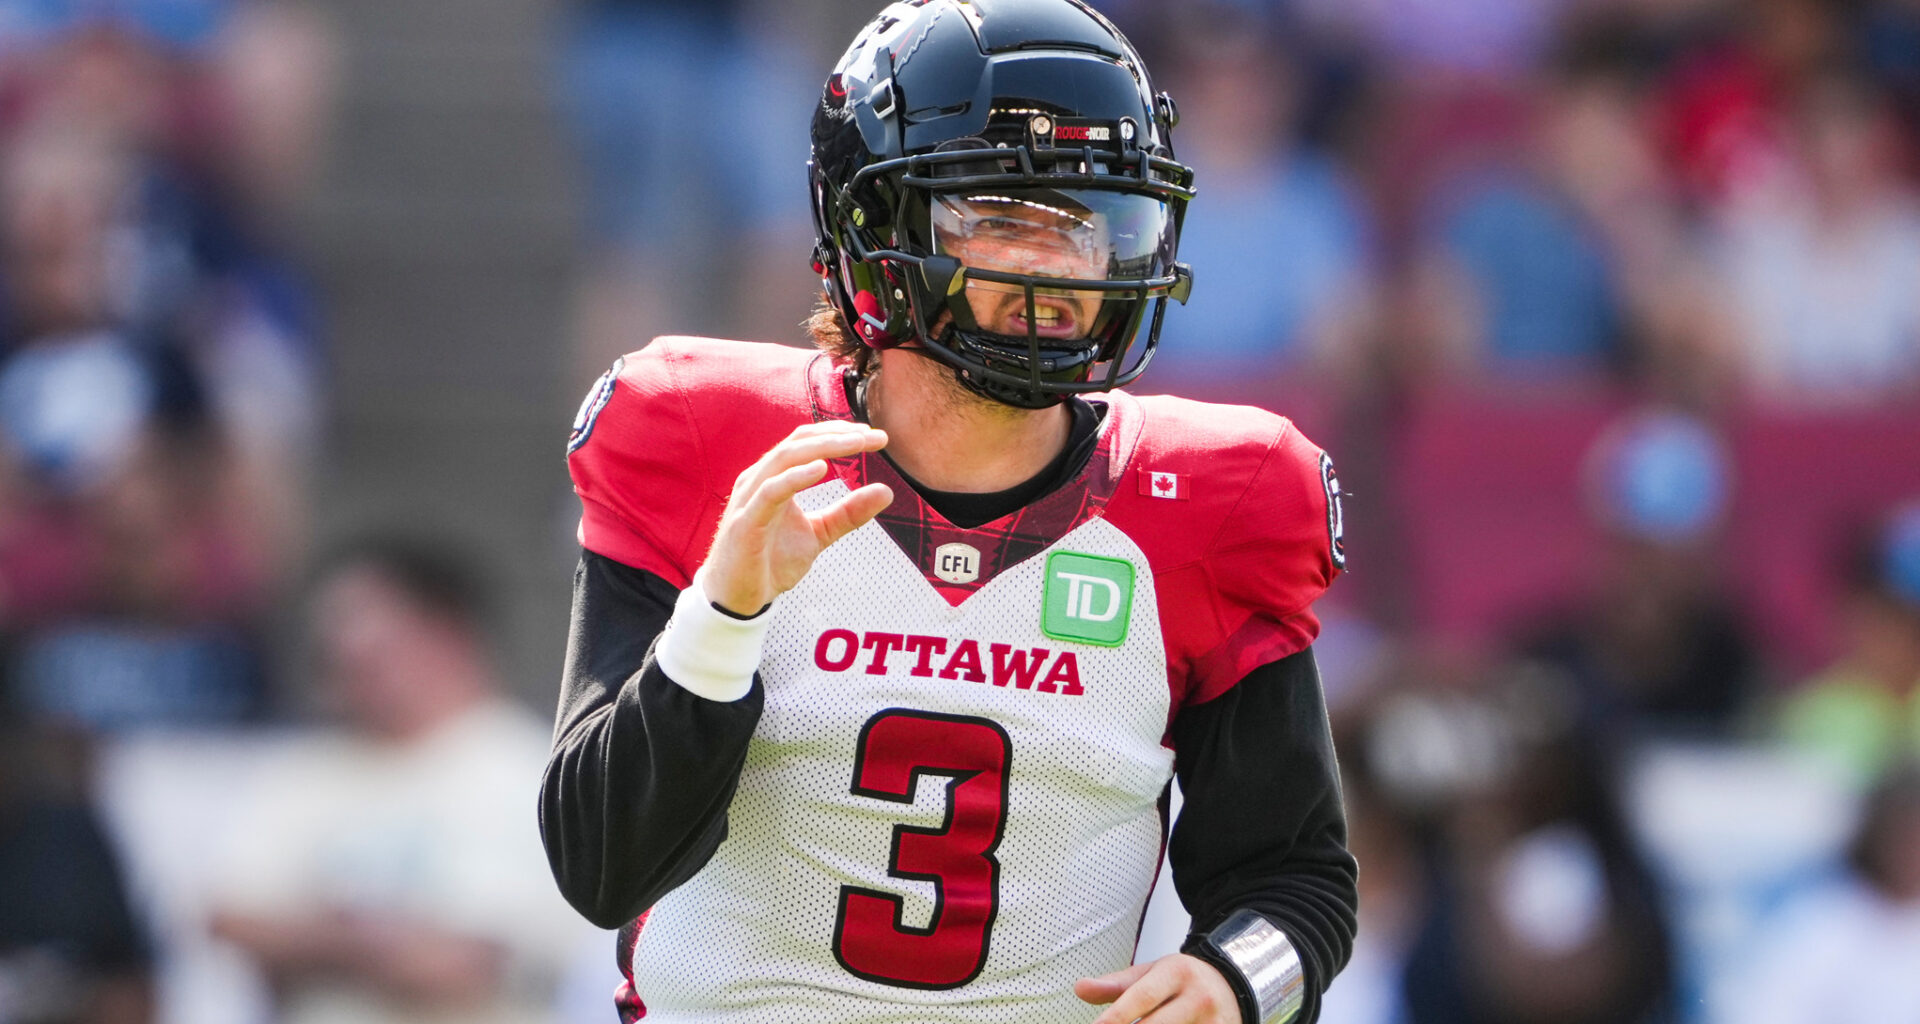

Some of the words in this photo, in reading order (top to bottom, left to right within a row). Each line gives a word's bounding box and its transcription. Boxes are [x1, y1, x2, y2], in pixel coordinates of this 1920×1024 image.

[941, 554, 972, 574] CFL
[1057, 572, 1121, 622] TD
[814, 628, 1085, 695] OTTAWA
[832, 707, 1012, 991] 3
